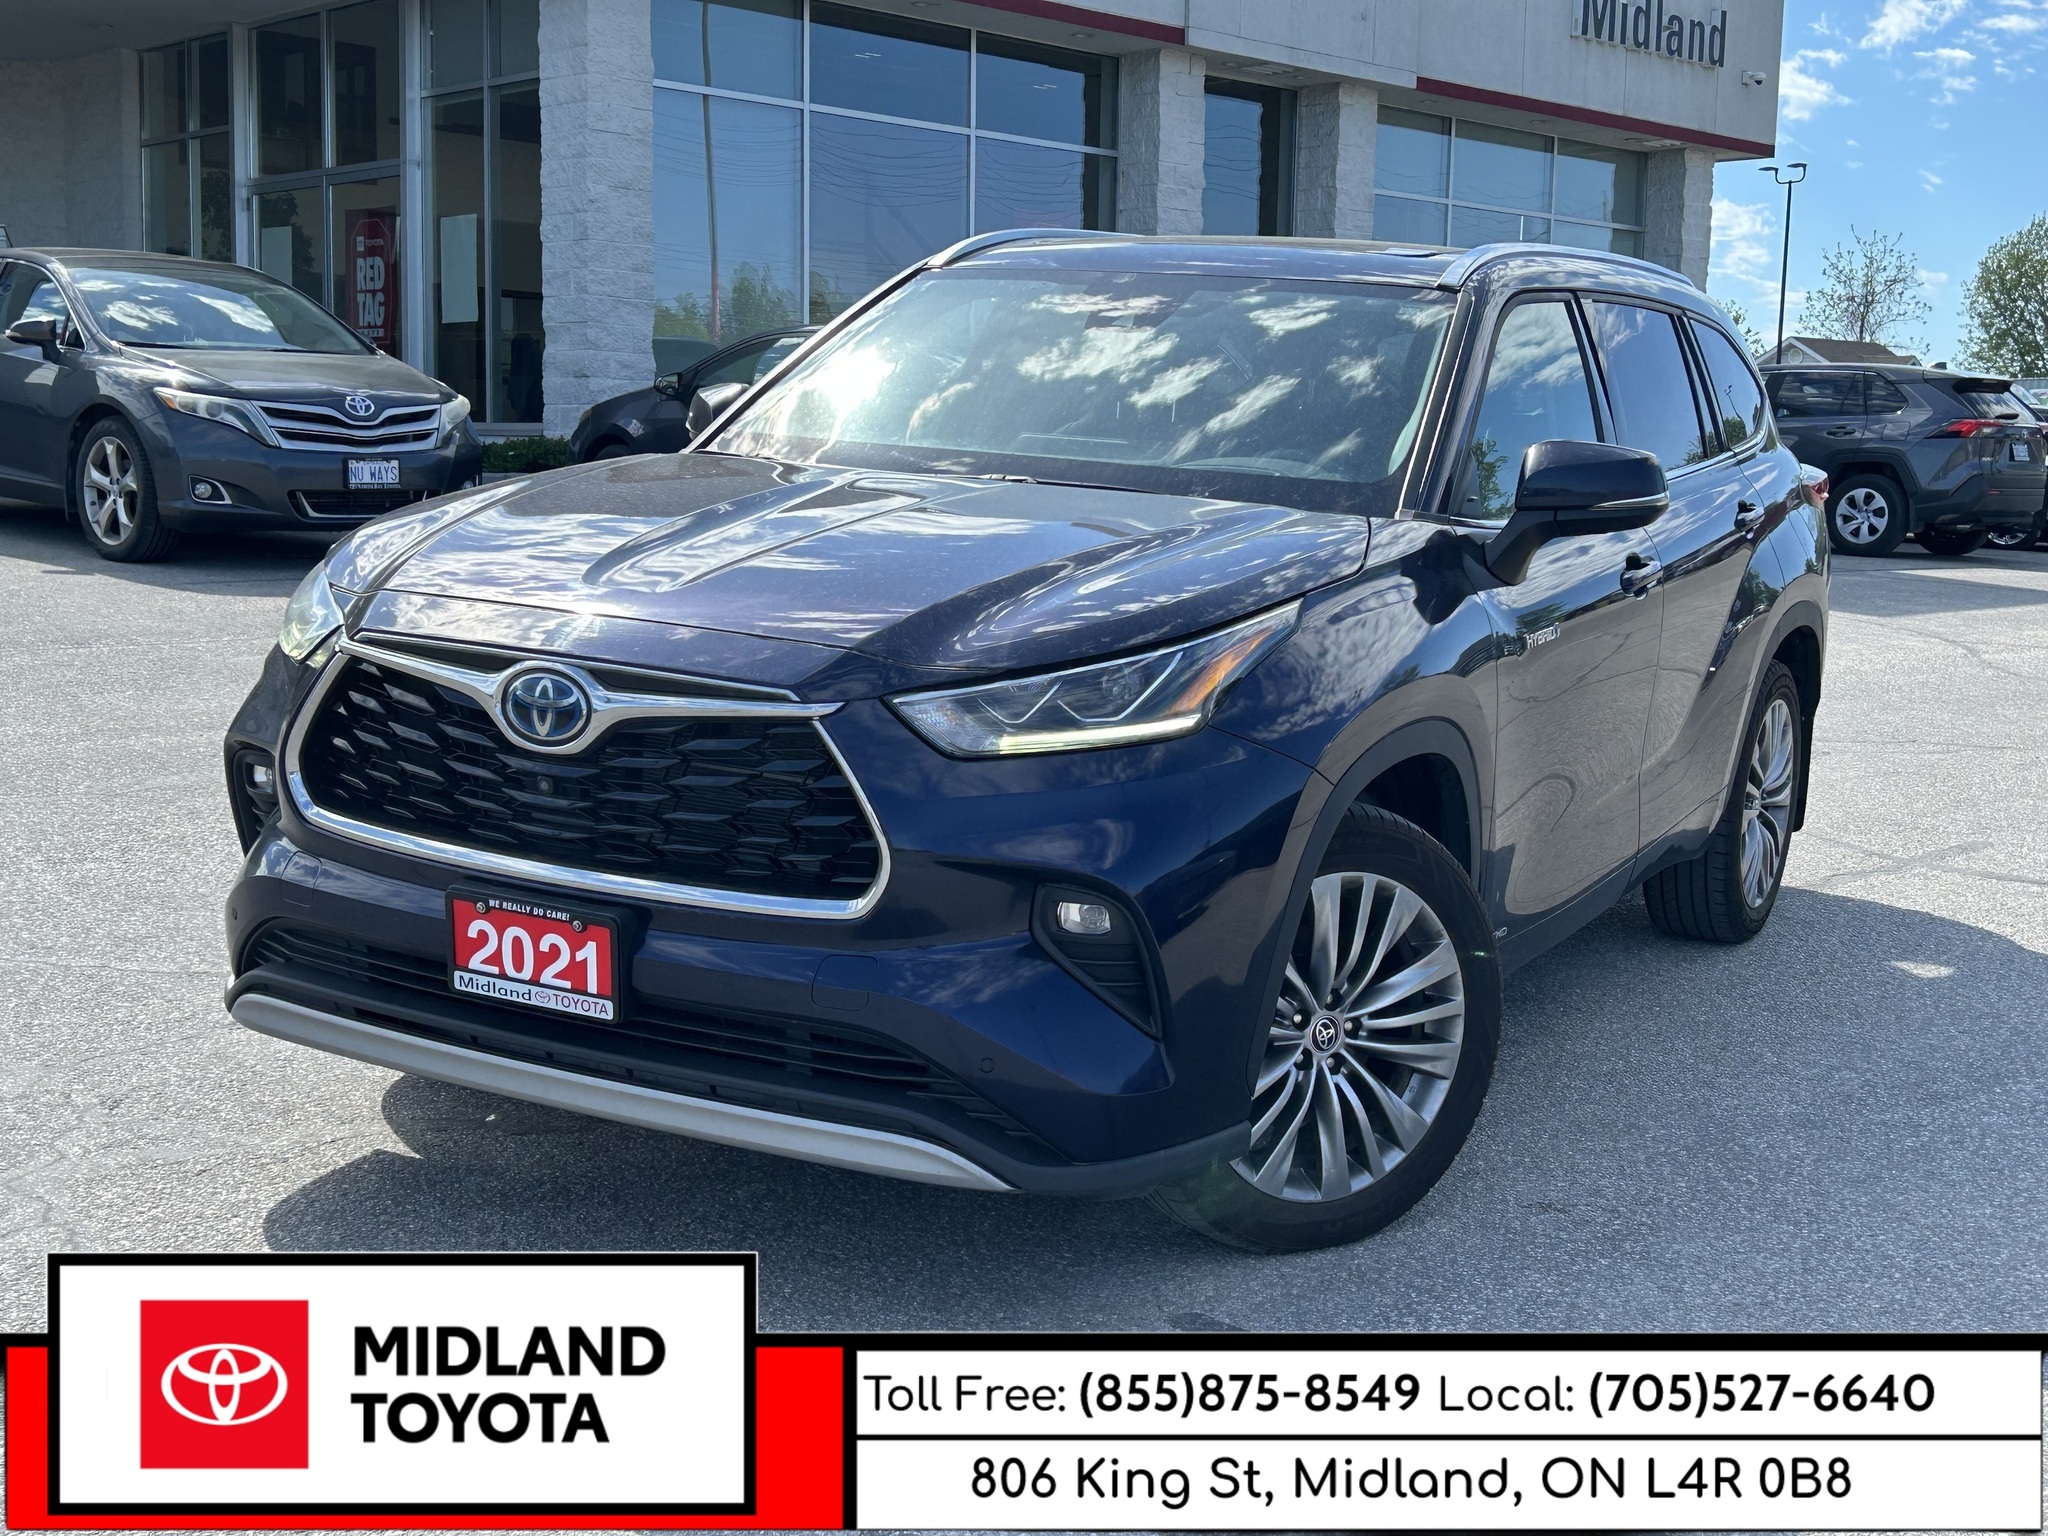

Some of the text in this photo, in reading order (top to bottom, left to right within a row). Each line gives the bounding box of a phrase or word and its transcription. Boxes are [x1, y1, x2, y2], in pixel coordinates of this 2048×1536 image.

[1581, 0, 1728, 68] Midland
[356, 256, 386, 291] RED
[357, 292, 386, 327] TAG
[350, 466, 398, 482] NU WAYS
[488, 899, 571, 922] WE REALLY DO CARE!
[467, 919, 598, 995] 2021
[458, 975, 609, 1017] Midland TOYOTA
